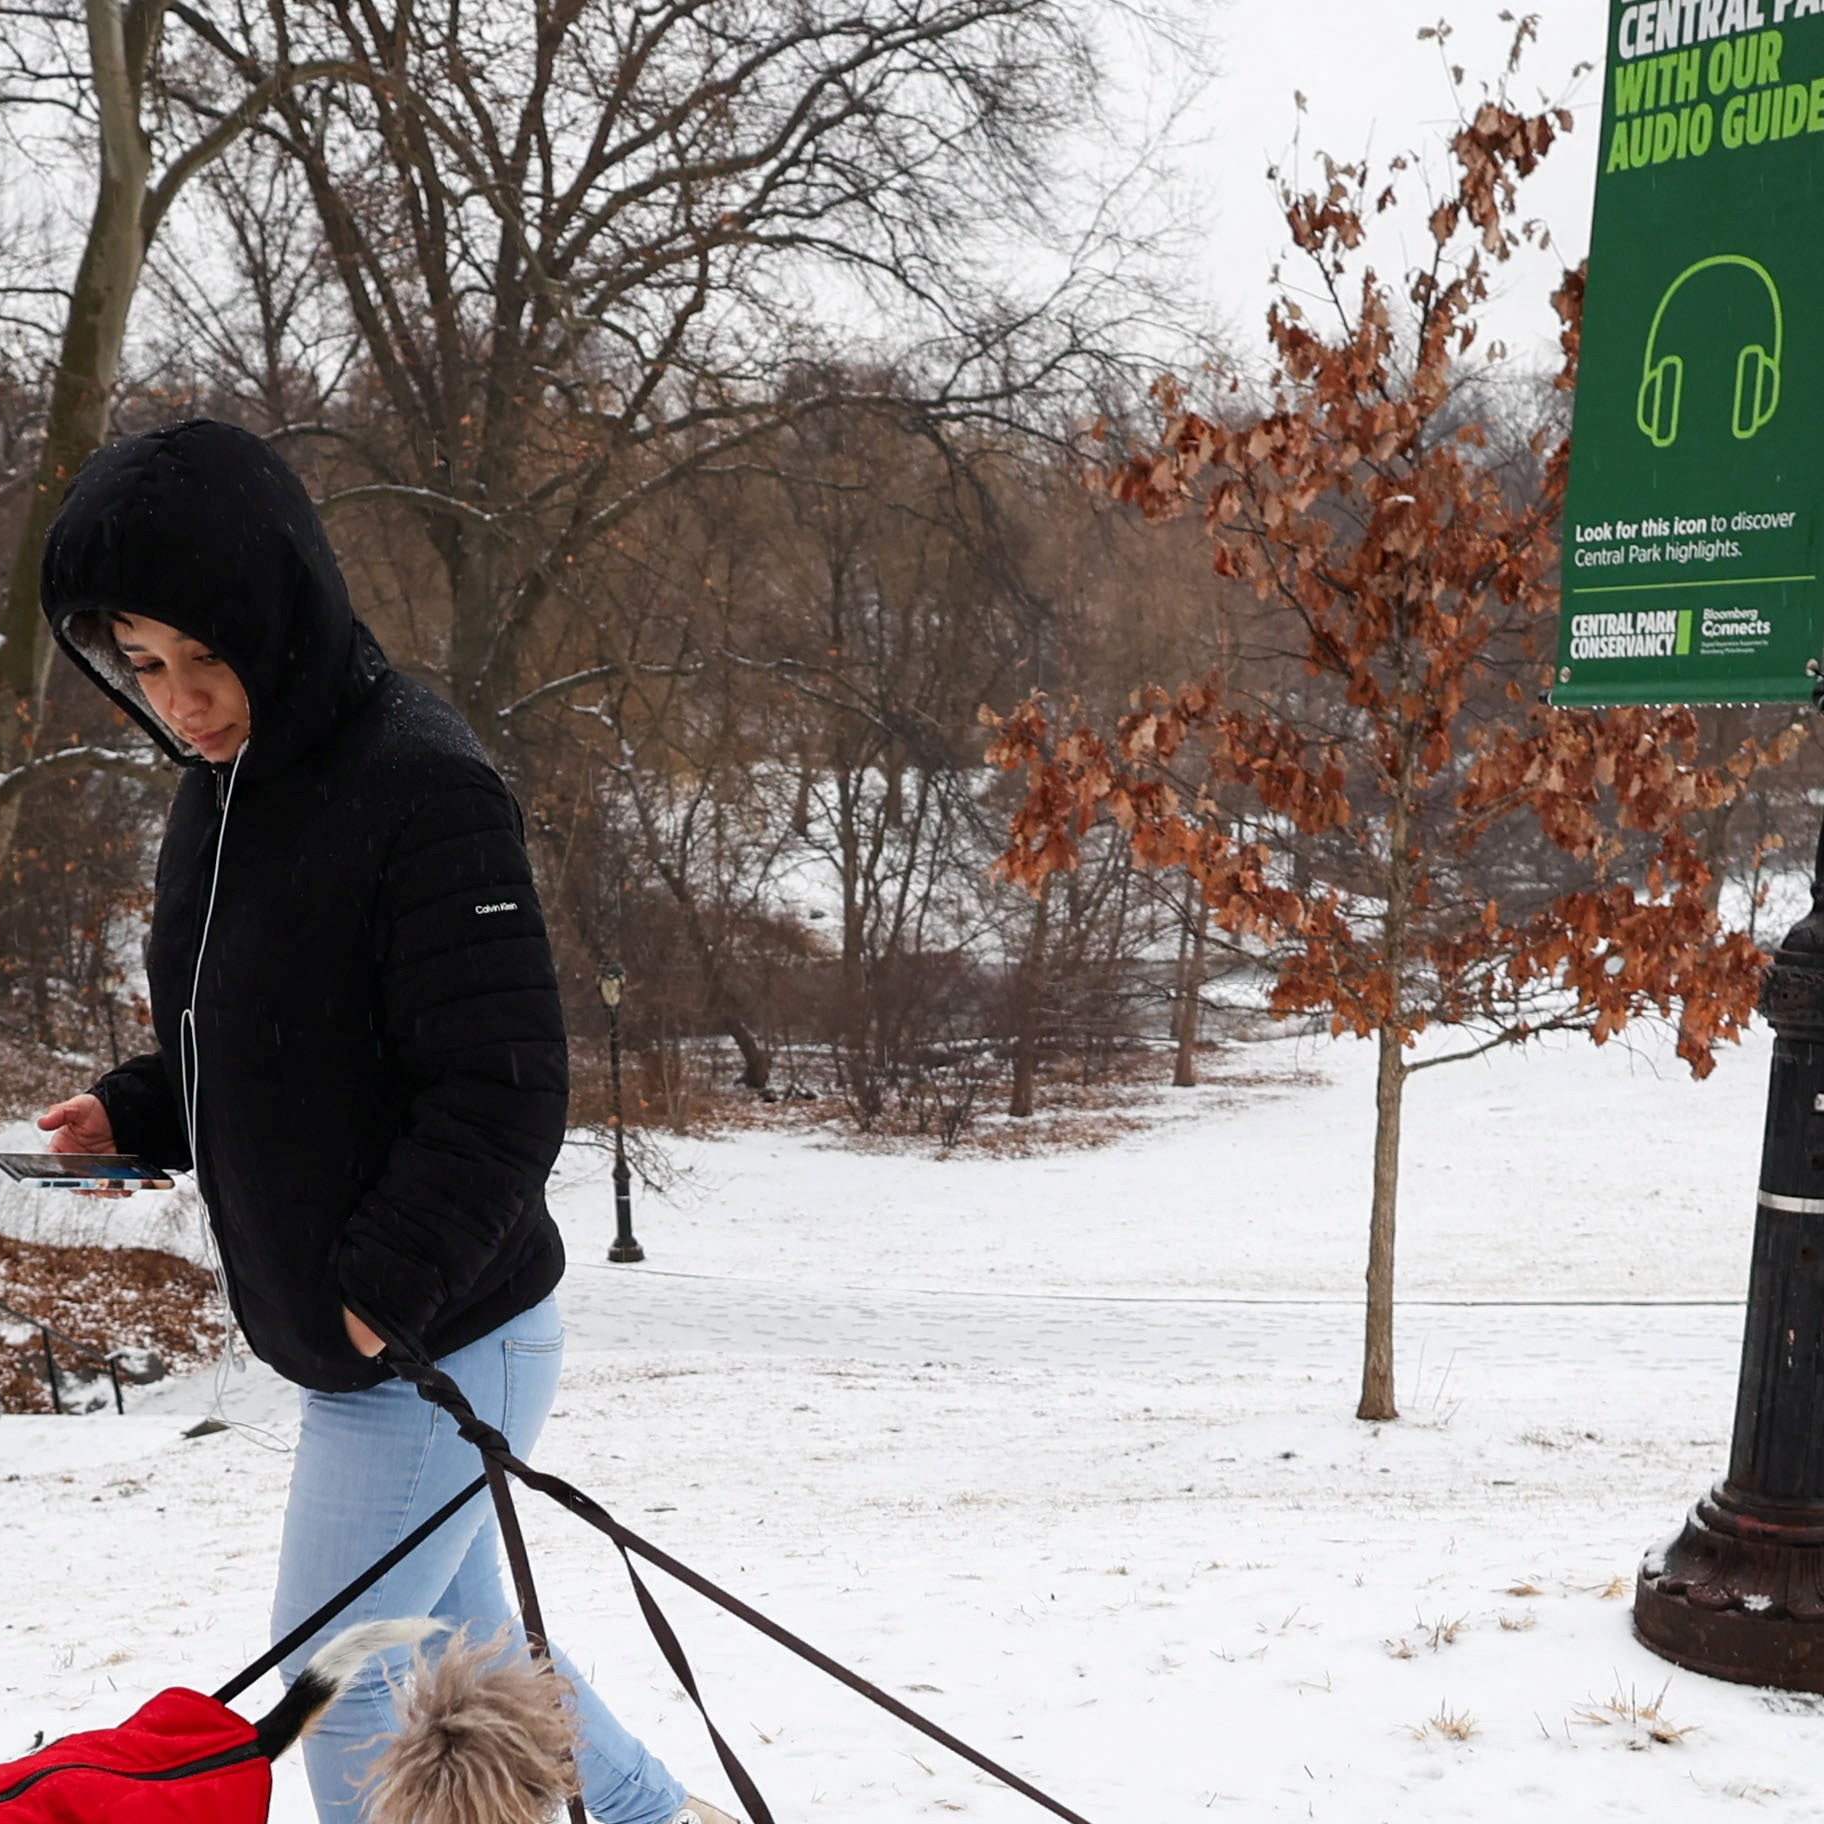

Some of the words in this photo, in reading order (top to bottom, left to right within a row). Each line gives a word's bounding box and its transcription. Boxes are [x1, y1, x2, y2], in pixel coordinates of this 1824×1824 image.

[1615, 48, 1701, 117] WITH
[1707, 29, 1783, 96] OUR
[1606, 103, 1714, 173] AUDIO
[1575, 520, 1613, 543] Look
[1616, 519, 1639, 540] for
[1641, 517, 1670, 538] this
[1674, 515, 1707, 535] icon
[1711, 514, 1727, 532] to
[1731, 510, 1797, 532] discover
[1574, 546, 1624, 567] Central
[1628, 543, 1661, 563] Park
[1665, 538, 1742, 564] highlights.
[1571, 611, 1634, 637] CENTRAL
[1636, 610, 1677, 634] PARK
[1703, 607, 1759, 621] Bloomberg
[1701, 619, 1771, 638] Connects
[1570, 633, 1675, 660] CONSERVANCY
[475, 904, 500, 915] Calvin
